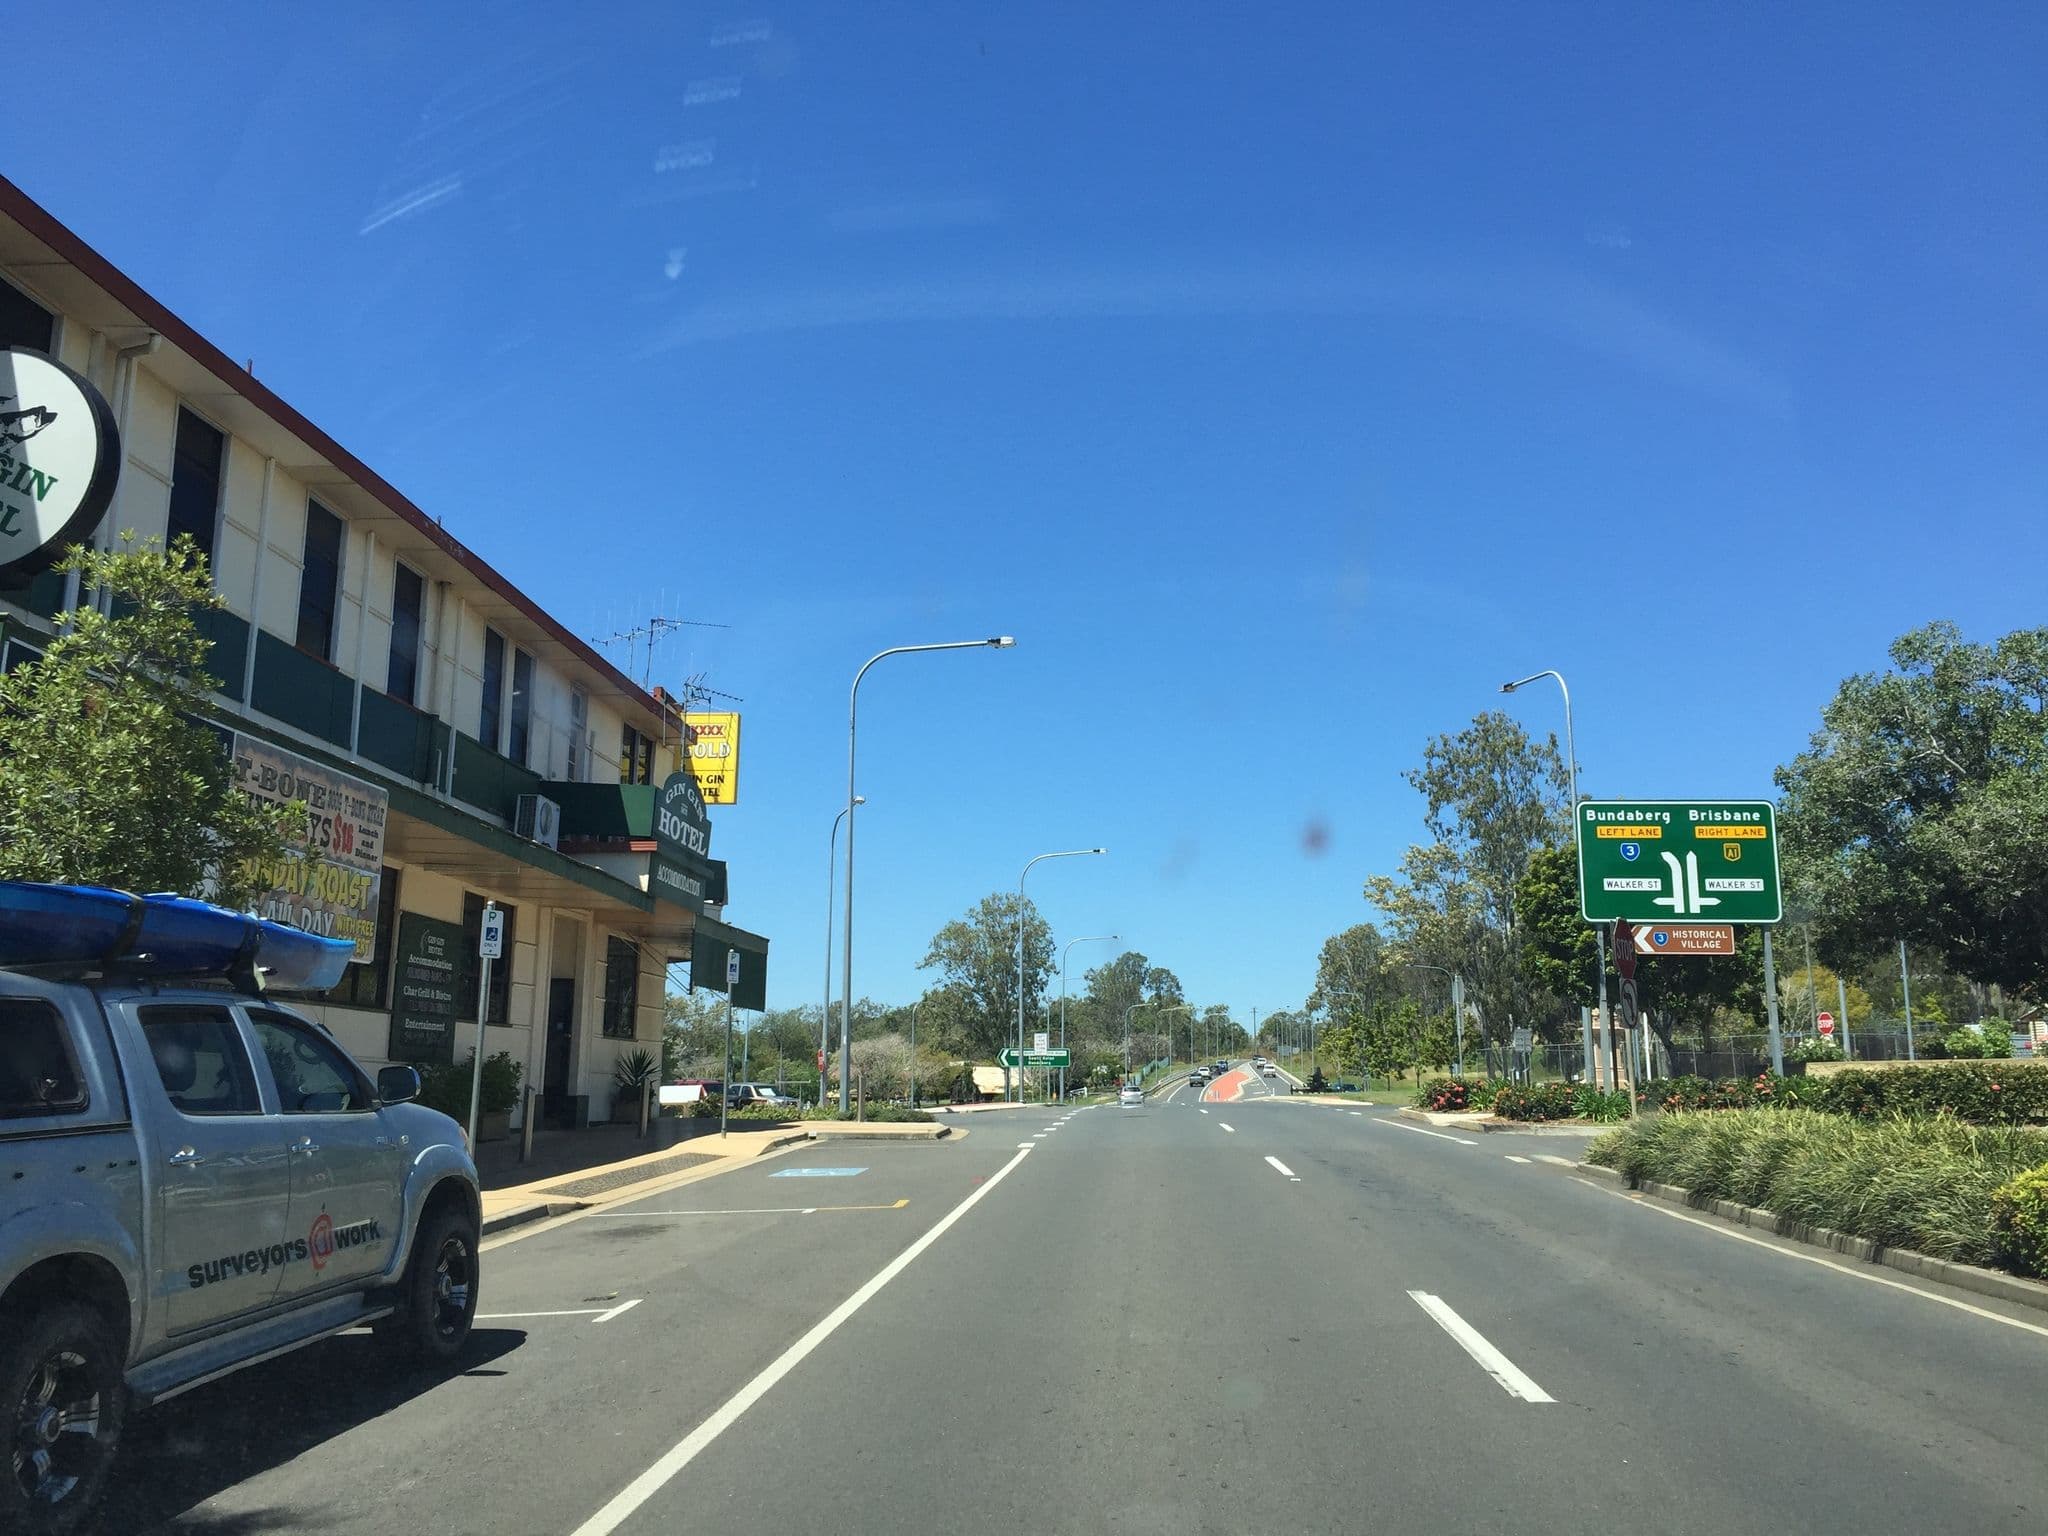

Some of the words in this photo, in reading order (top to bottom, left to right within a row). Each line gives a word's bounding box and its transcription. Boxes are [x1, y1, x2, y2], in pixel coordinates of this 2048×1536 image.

[236, 753, 327, 810] T-BONE
[706, 774, 725, 784] GIN
[665, 782, 686, 804] GIN
[687, 788, 705, 822] GIN
[1585, 809, 1671, 825] Bundaberg
[1688, 809, 1761, 821] Brisbane
[358, 824, 379, 839] Lunch
[658, 807, 707, 856] HOTEL
[1599, 828, 1625, 837] LEFT
[1630, 828, 1660, 837] LANE
[1698, 828, 1729, 837] RIGHT
[1734, 828, 1764, 837] LANE
[360, 839, 374, 850] and
[1626, 846, 1635, 856] 3
[354, 848, 378, 862] Dinner
[1727, 848, 1738, 859] A1
[314, 863, 373, 911] ROAST
[657, 864, 701, 897] ACCOMMODATION
[1606, 880, 1643, 889] WALKER
[1647, 880, 1659, 889] ST
[1708, 881, 1746, 889] WALKER
[1750, 881, 1761, 889] ST
[301, 906, 336, 937] DAY
[356, 919, 375, 938] FREE
[1657, 934, 1665, 943] 3
[1672, 930, 1728, 939] HISTORICAL
[1616, 938, 1633, 961] STOP
[1680, 940, 1721, 949] VILLAGE
[408, 953, 453, 970] Accommodation
[405, 1018, 446, 1032] Entertainment
